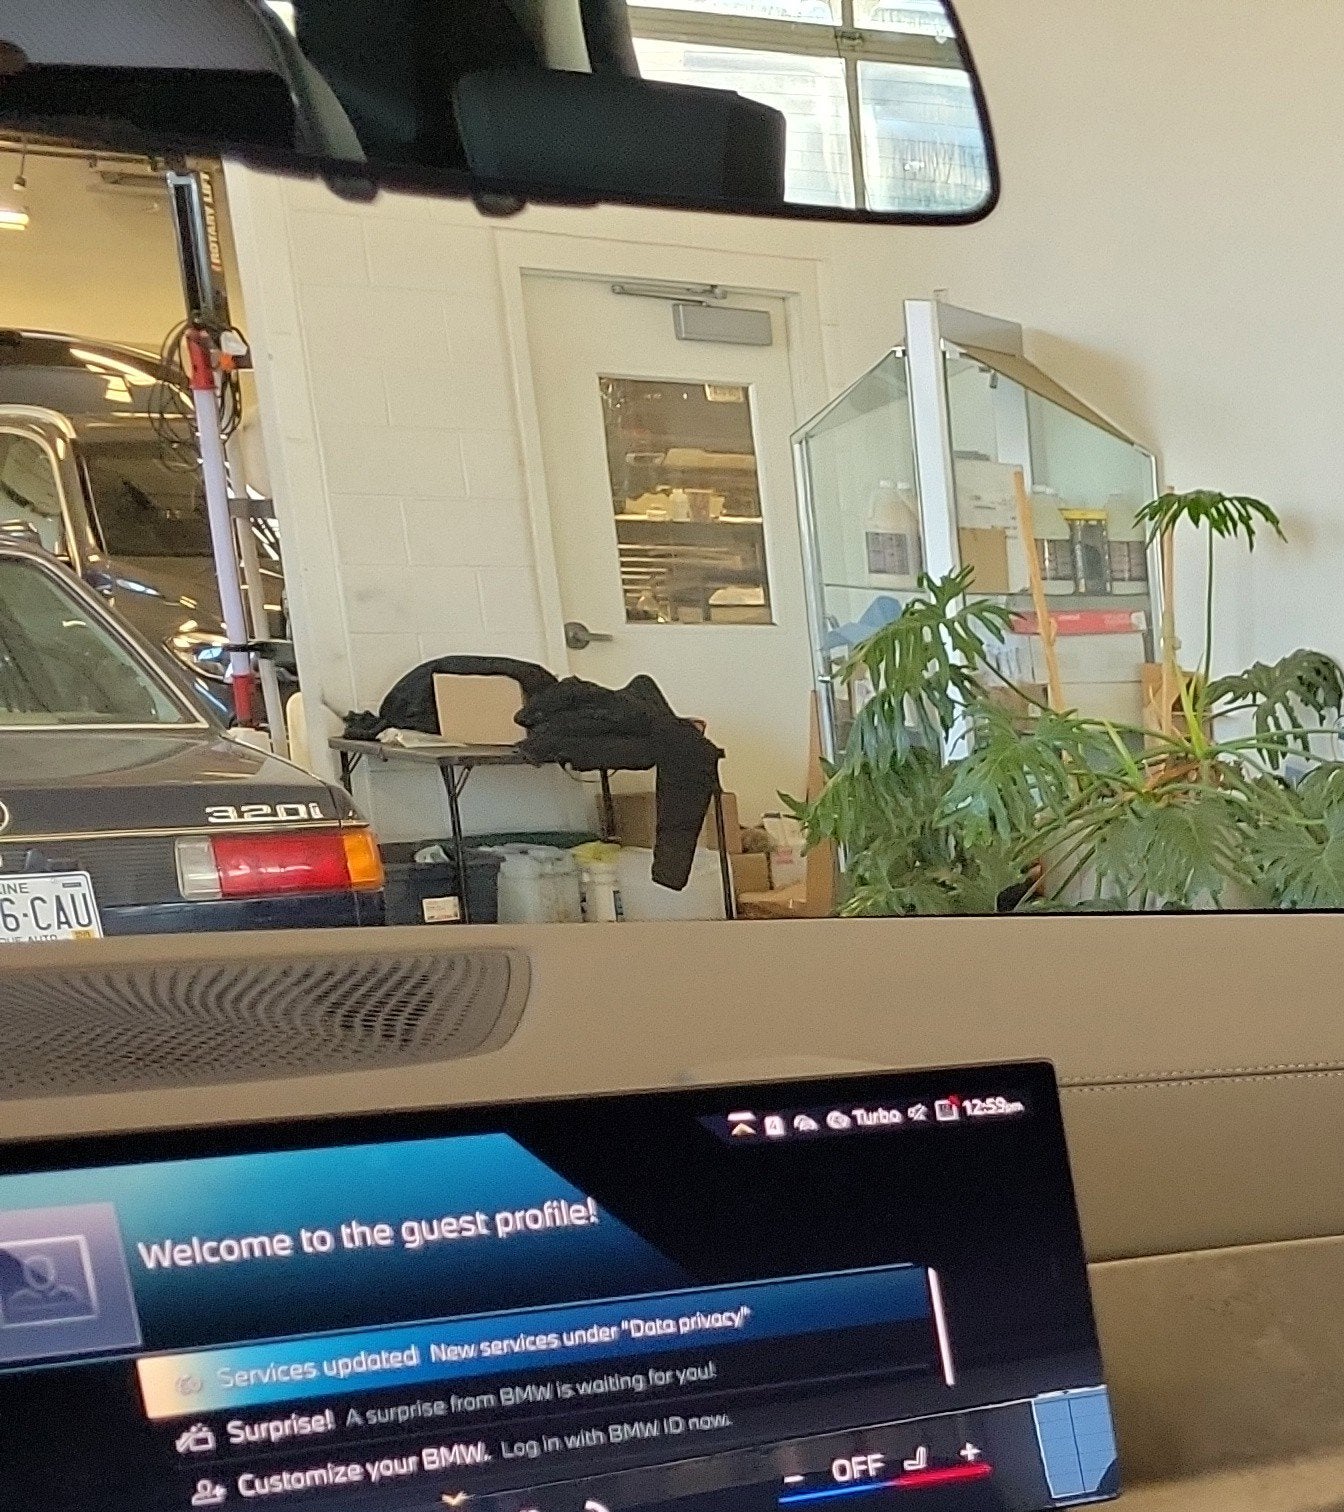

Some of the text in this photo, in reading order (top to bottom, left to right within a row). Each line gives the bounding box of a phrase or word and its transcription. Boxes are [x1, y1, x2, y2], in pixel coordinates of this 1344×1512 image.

[204, 802, 324, 823] 320i
[0, 882, 29, 894] INE
[852, 1107, 903, 1126] Turbo
[139, 1196, 600, 1270] Welcome to the guest profile!
[217, 1360, 319, 1389] Services
[323, 1344, 421, 1379] updated
[430, 1341, 477, 1363] New
[481, 1331, 562, 1358] services
[562, 1323, 618, 1347] under
[226, 1361, 717, 1444] Surprise! A surprise from BMW is waiting for you!
[237, 1413, 734, 1498] Customize your BMW. Log in with BMW ID now.
[832, 1453, 885, 1482] OFF
